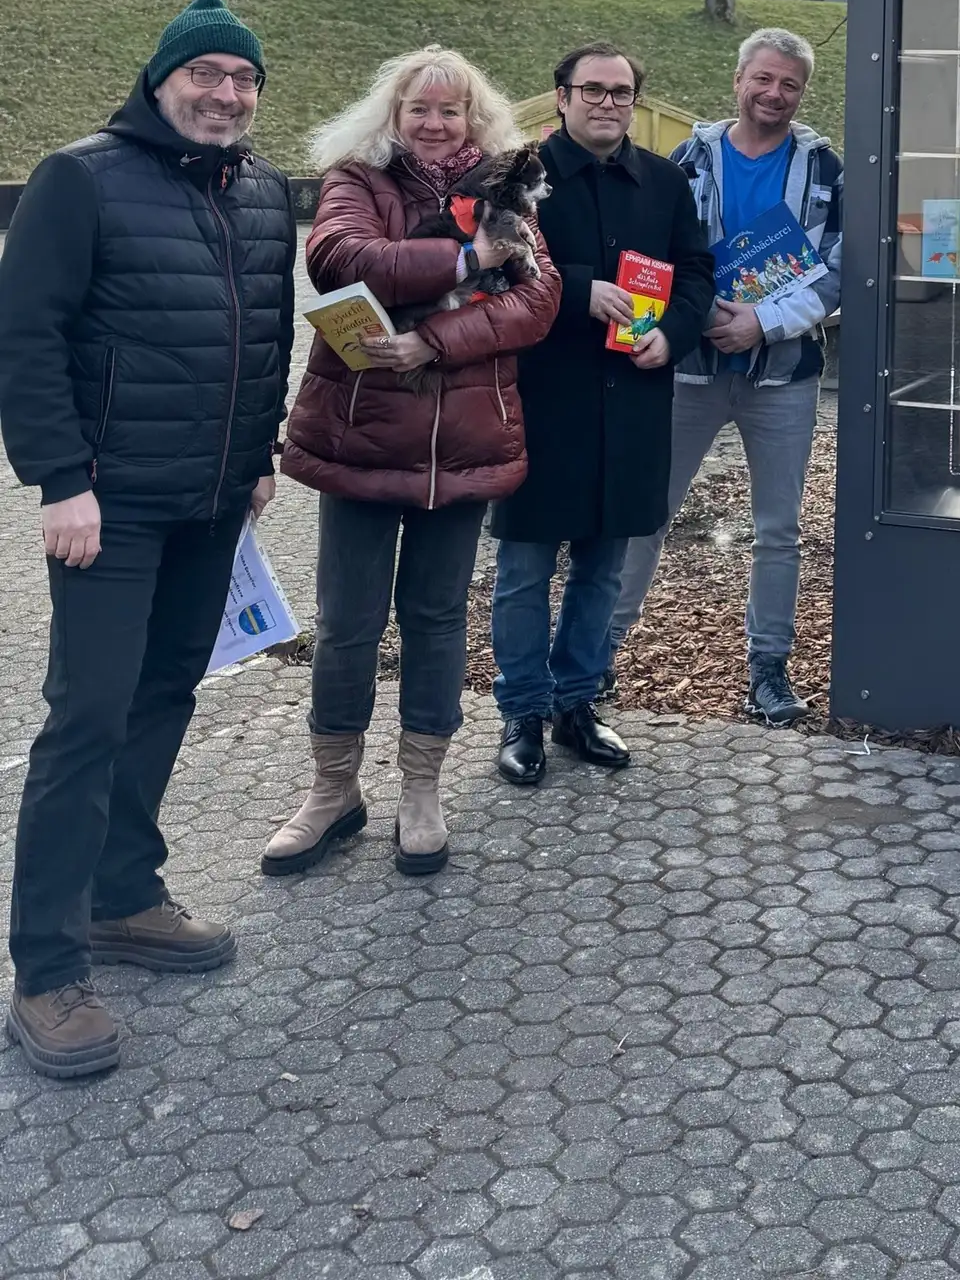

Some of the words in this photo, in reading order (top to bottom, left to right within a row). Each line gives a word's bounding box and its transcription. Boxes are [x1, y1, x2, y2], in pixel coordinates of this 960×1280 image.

[625, 253, 650, 266] EPHRAIM
[651, 260, 673, 272] KISHON
[714, 223, 793, 278] eihnachtsbäckerei
